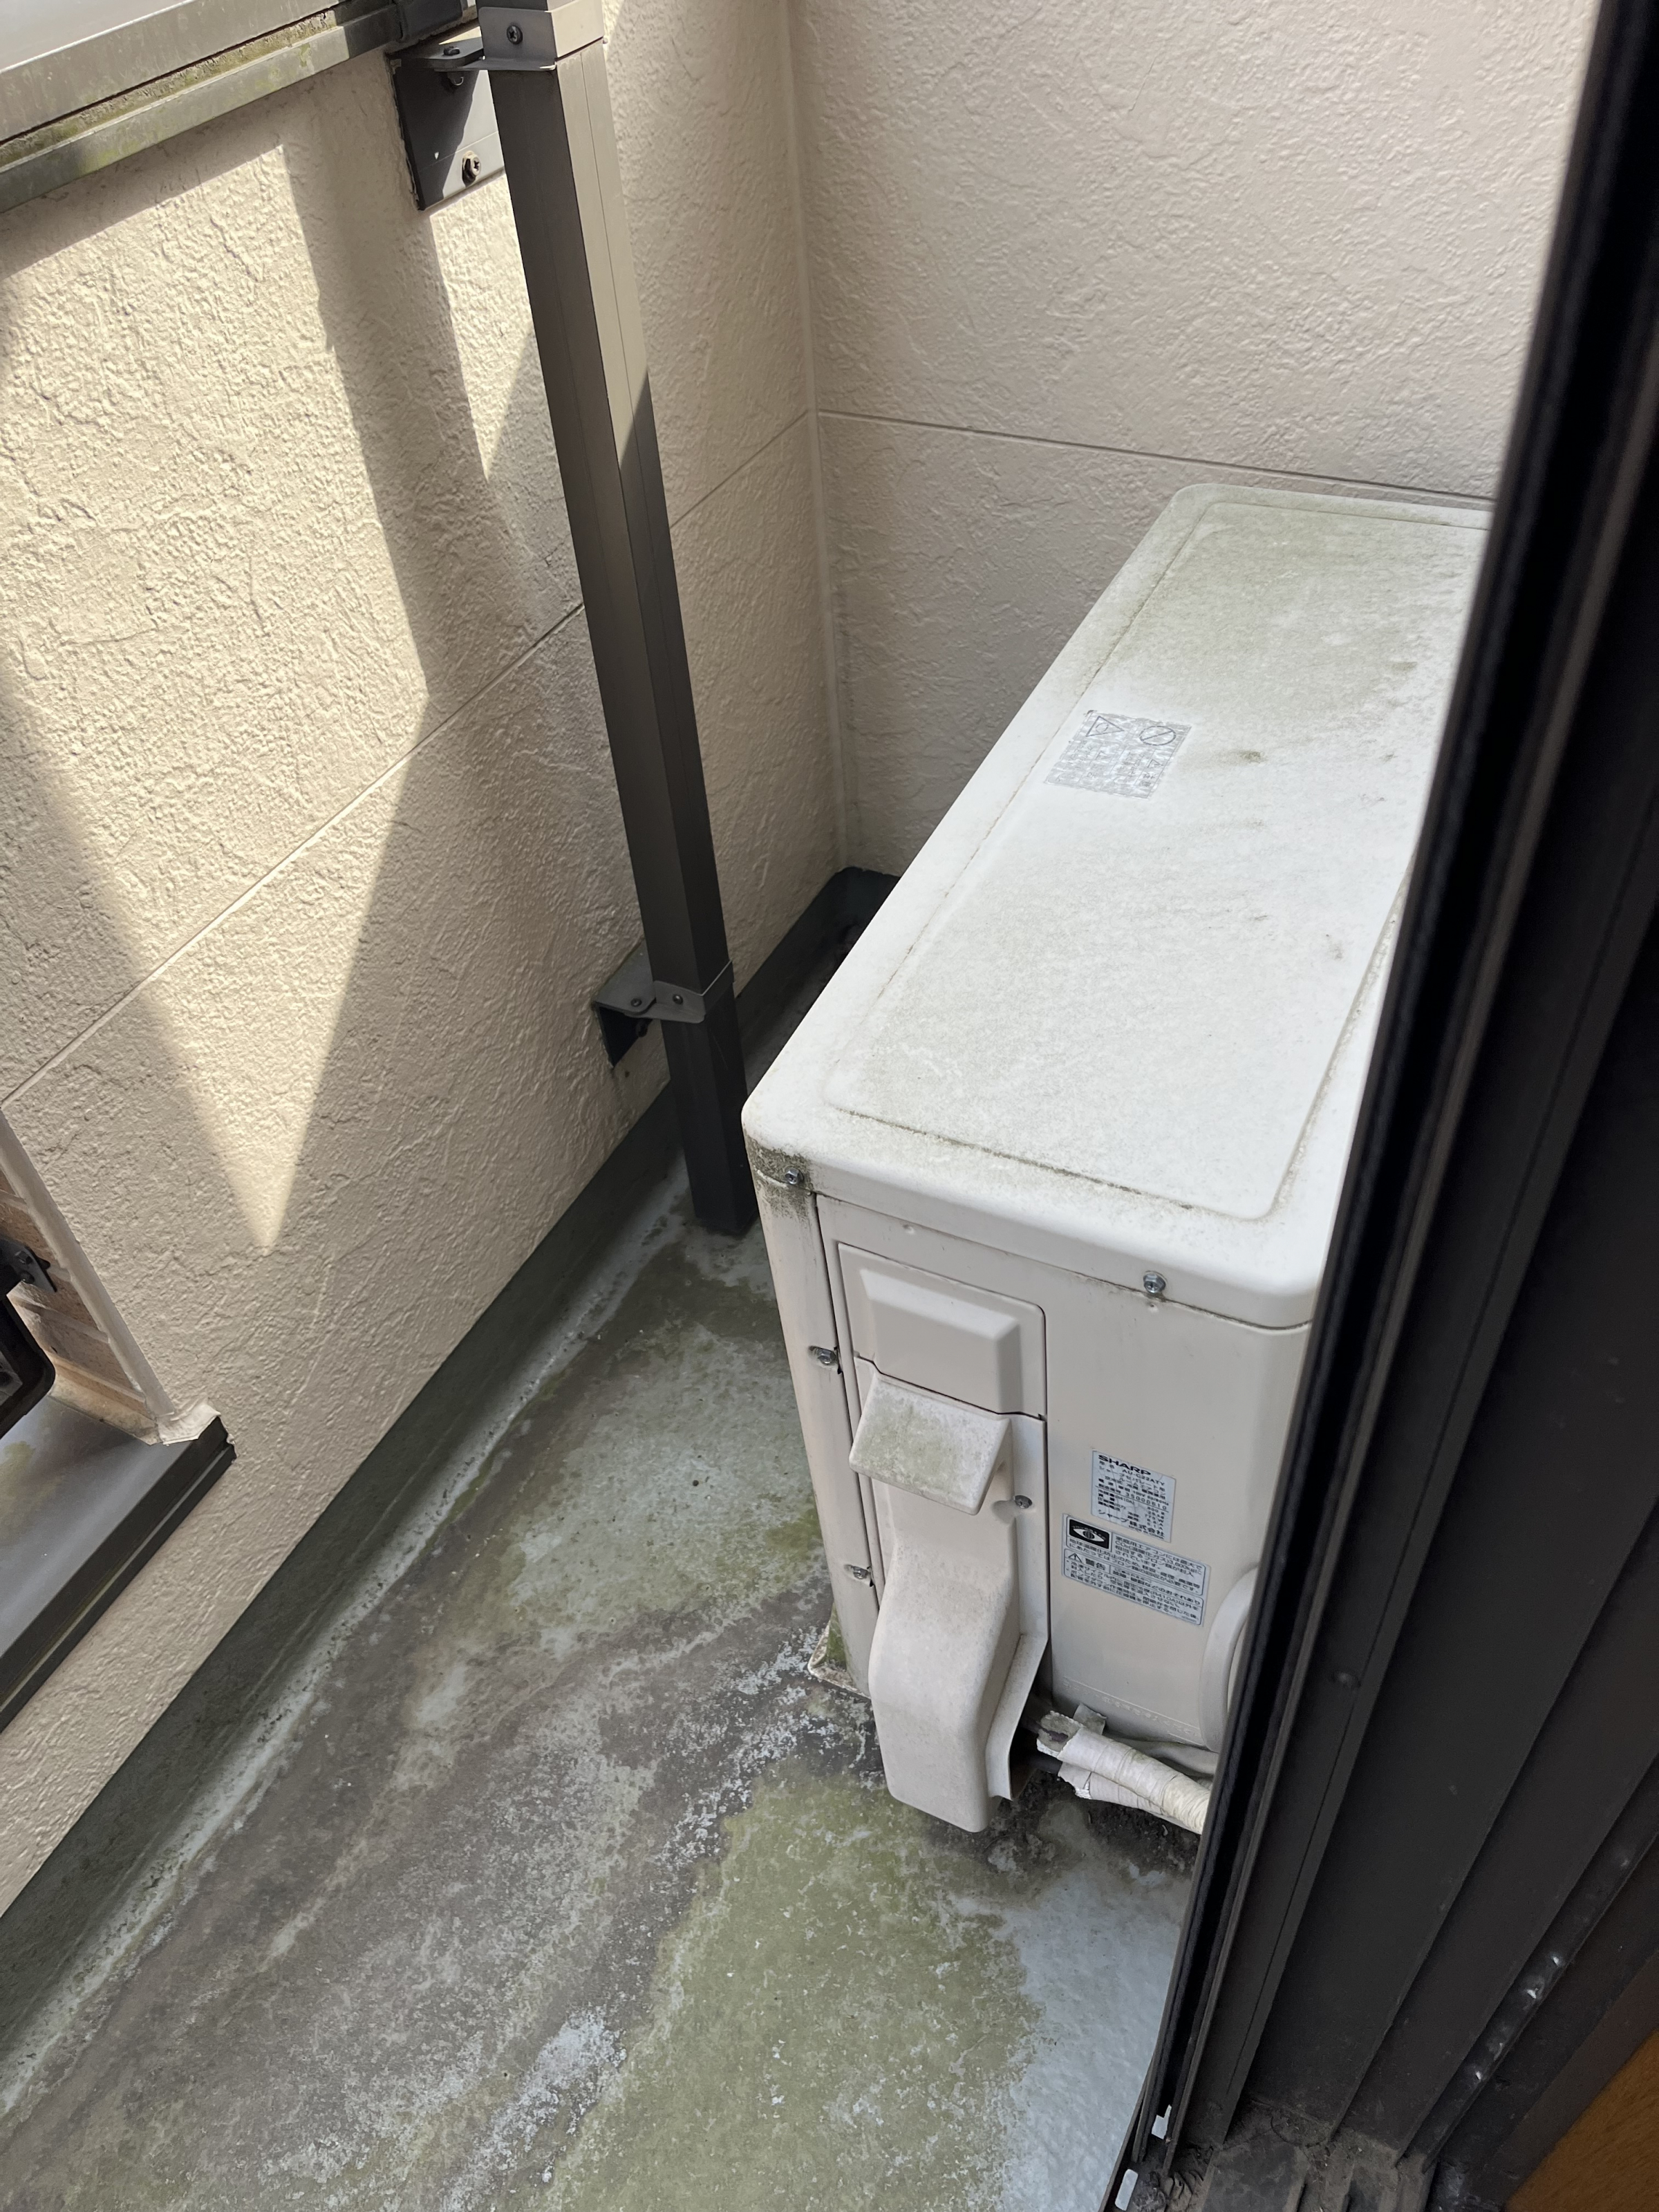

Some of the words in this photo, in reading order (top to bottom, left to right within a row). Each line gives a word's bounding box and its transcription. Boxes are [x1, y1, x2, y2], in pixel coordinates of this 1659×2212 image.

[1098, 1454, 1151, 1477] SHARP
[1098, 1509, 1165, 1537] シャープ株式会社
